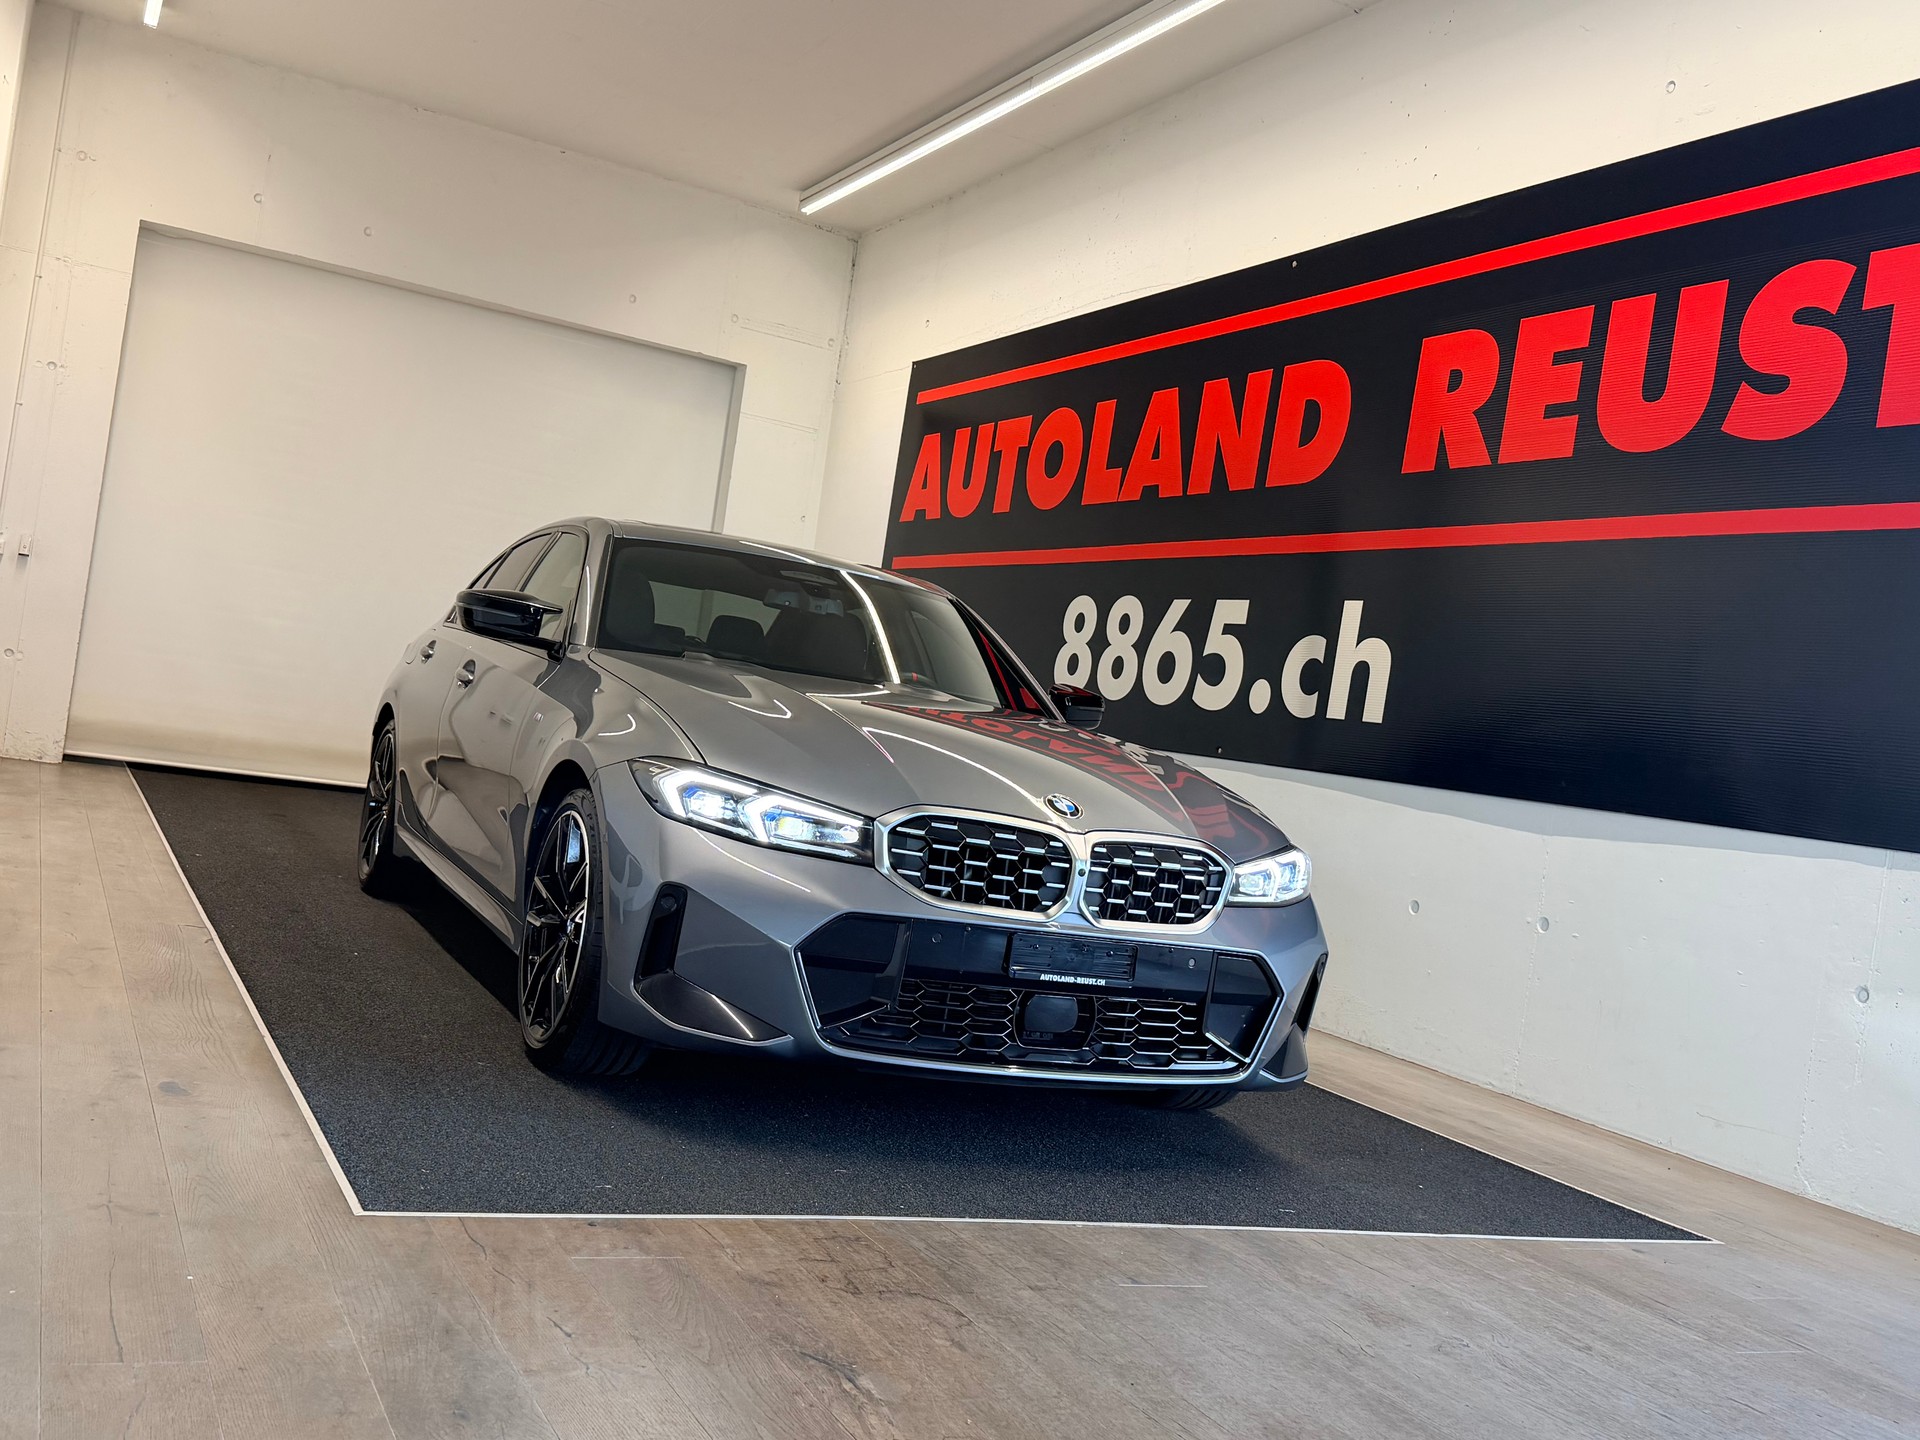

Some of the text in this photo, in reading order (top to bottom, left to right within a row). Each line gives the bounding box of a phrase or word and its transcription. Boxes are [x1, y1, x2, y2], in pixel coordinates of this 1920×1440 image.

[899, 242, 1920, 523] AUTOLAND REUST
[1053, 595, 1392, 724] 8865.ch
[1040, 973, 1106, 986] AUTOLAND-REUST.CH
